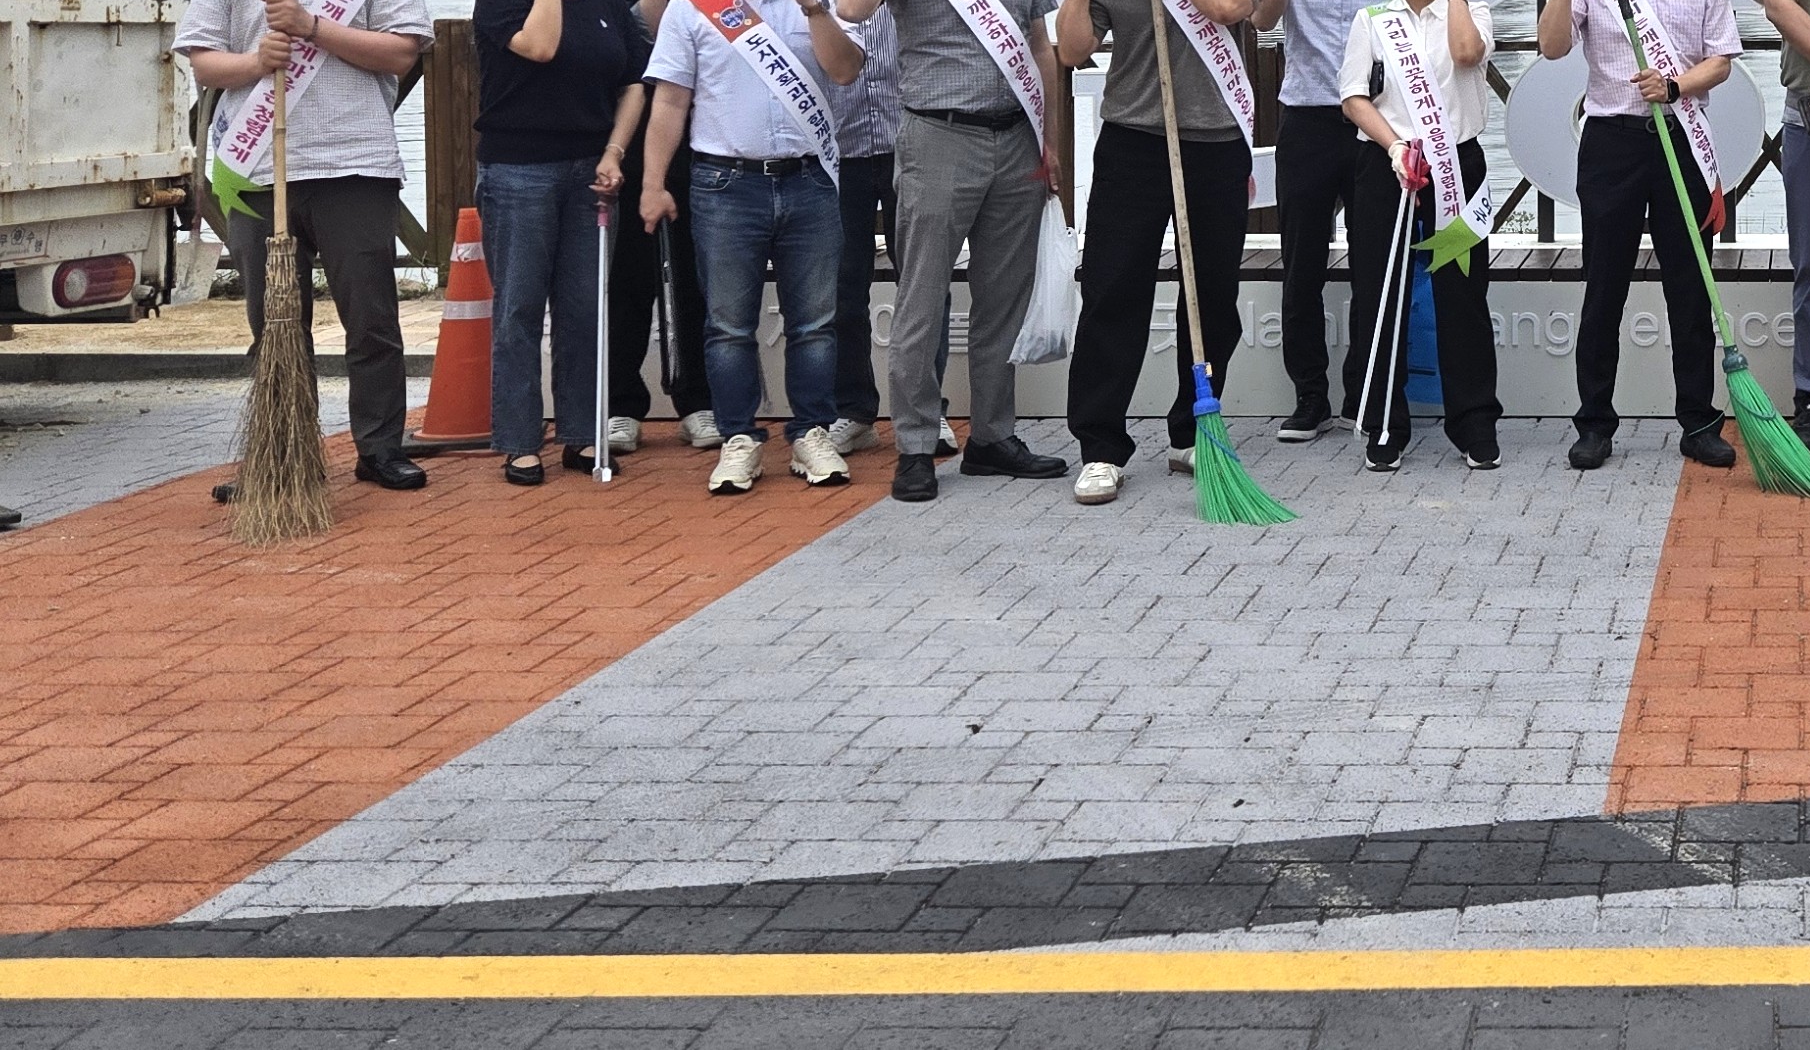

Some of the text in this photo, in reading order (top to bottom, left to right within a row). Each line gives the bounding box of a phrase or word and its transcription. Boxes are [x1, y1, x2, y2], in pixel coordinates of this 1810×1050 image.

[745, 32, 818, 115] 도시계획과와
[1007, 50, 1036, 93] 마음은
[1226, 76, 1253, 116] 마음은
[227, 104, 275, 164] 청렴하게
[1383, 17, 1413, 54] 거리는
[1421, 111, 1450, 157] 마음은
[1437, 160, 1460, 218] 청렴하게
[1691, 122, 1719, 179] 청렴하게
